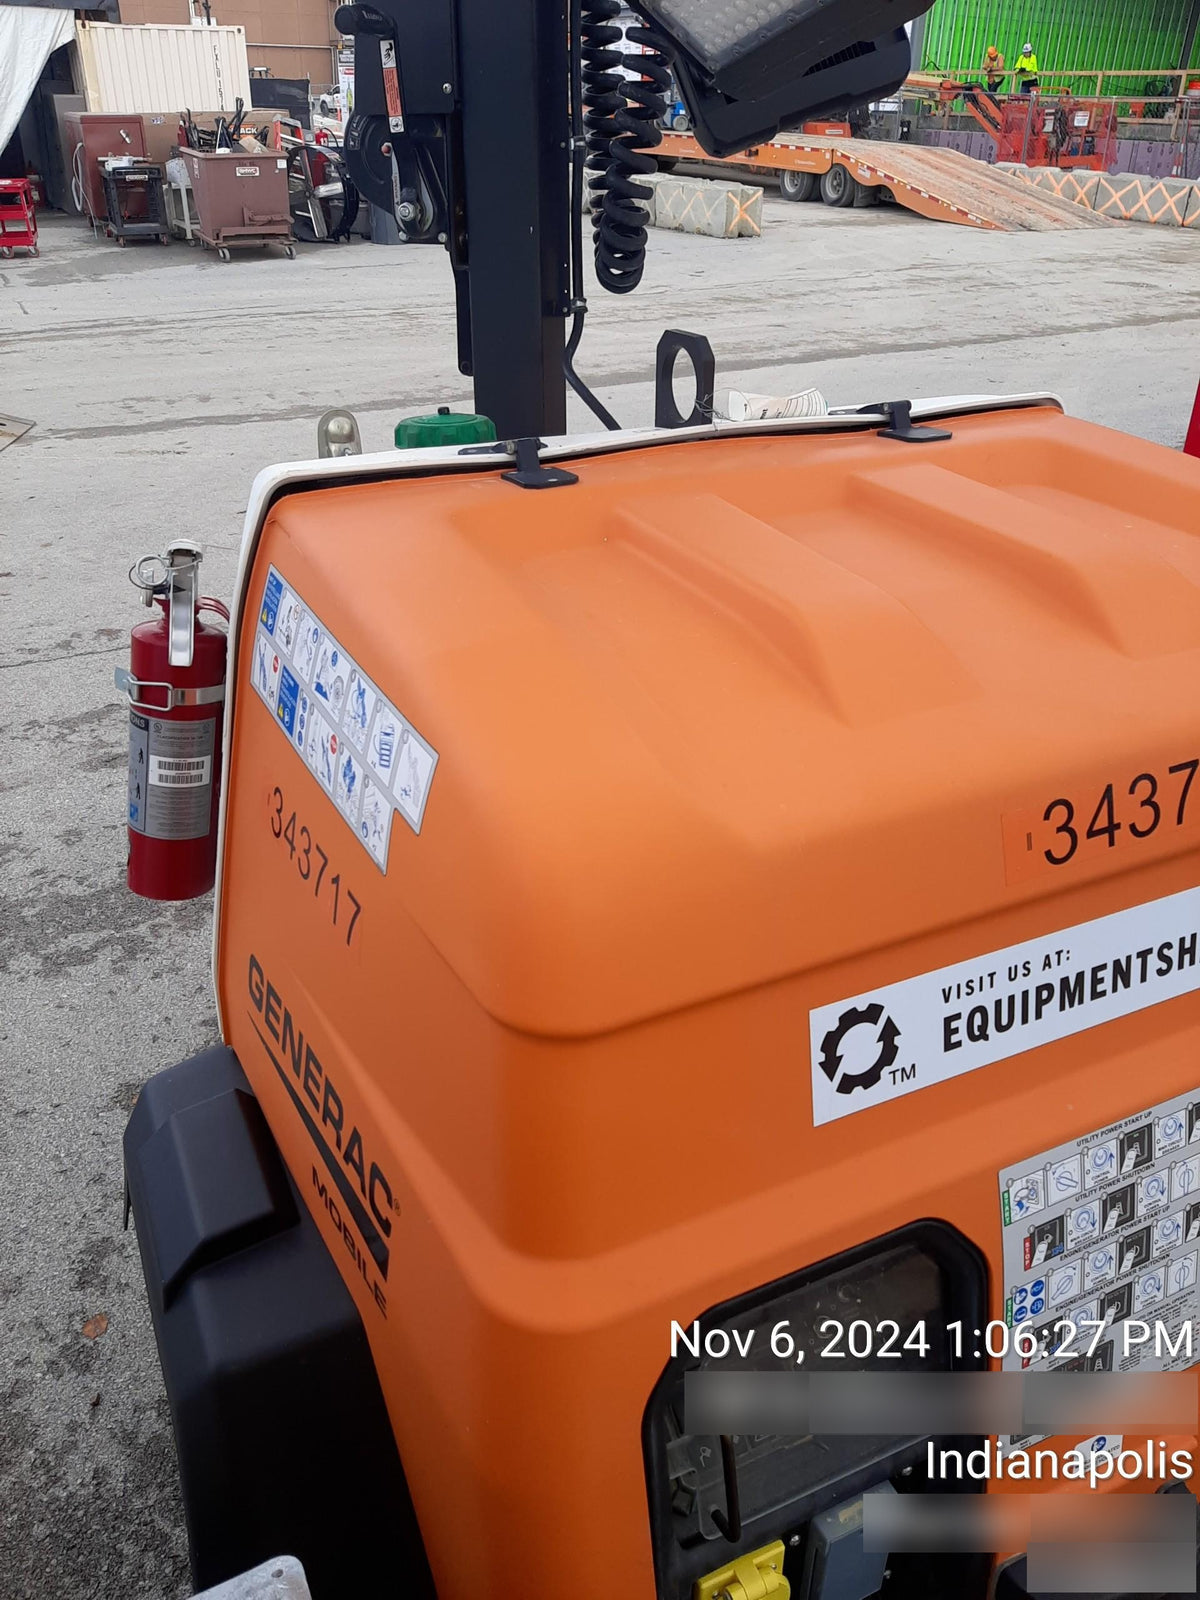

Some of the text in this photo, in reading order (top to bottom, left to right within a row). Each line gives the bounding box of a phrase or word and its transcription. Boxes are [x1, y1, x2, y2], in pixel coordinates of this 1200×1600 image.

[1043, 759, 1199, 865] 3437
[270, 786, 362, 946] 343717
[942, 950, 1070, 1003] VISIT US AT:
[943, 932, 1200, 1053] EQUIPMENTSH
[248, 953, 394, 1238] GENERAC
[889, 1063, 916, 1085] TM
[1076, 1110, 1153, 1147] UTILITY POWER START UP
[1075, 1162, 1156, 1202] UTILITY POWER SHUTDOWN
[311, 1163, 389, 1320] MOBILE
[1059, 1205, 1171, 1261] ENGINE/GENERATOR POWER START UP
[1115, 1269, 1137, 1283] POWER
[1137, 1252, 1171, 1272] SHUTDOWN
